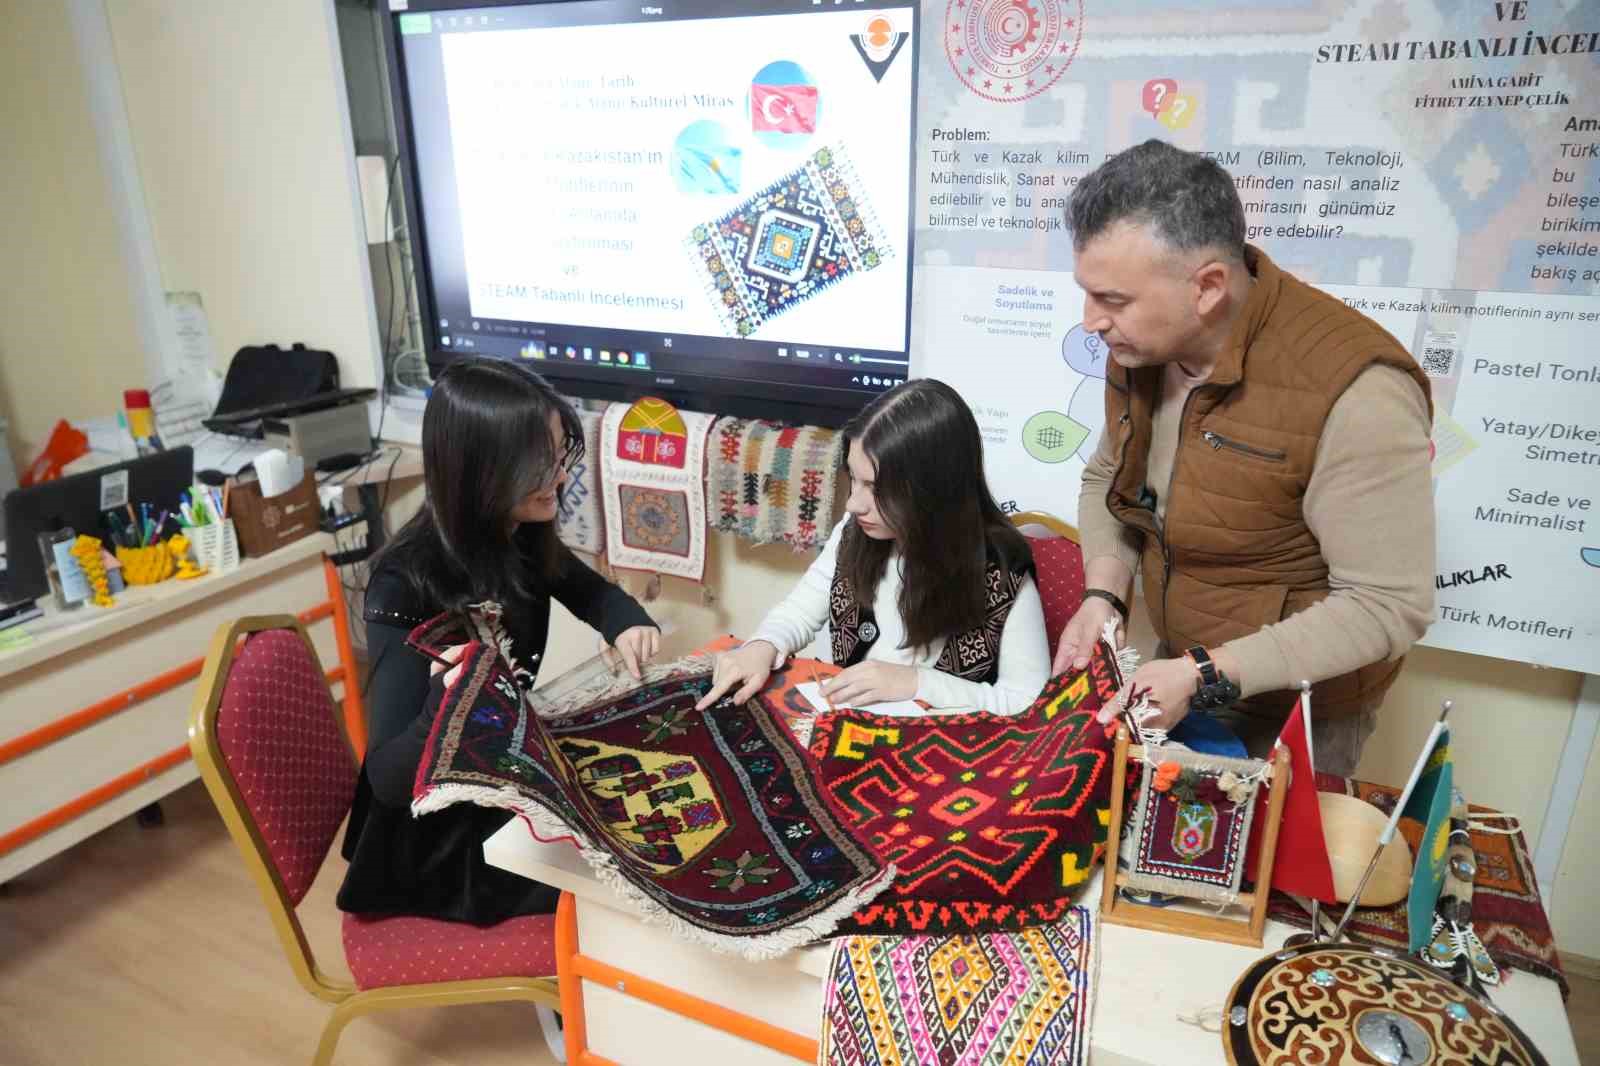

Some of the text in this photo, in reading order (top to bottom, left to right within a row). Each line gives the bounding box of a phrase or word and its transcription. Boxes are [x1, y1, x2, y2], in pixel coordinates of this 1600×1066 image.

[1495, 0, 1528, 22] VE
[1316, 41, 1400, 63] STEAM
[1406, 36, 1518, 60] TABANLI
[1450, 73, 1544, 89] AMİNA GABİT
[1468, 95, 1524, 108] ZEYNEP
[1526, 91, 1570, 109] ÇELİK
[1564, 116, 1600, 132] Am
[932, 128, 990, 141] Problem:
[932, 150, 1089, 164] Türk ve Kazak kilim
[1560, 143, 1600, 158] Türk
[1258, 151, 1306, 168] (Bilim,
[1326, 152, 1404, 170] Teknoloji,
[930, 172, 1078, 186] Mühendislik, Sanat ve
[1233, 174, 1400, 192] tifinden nasıl analiz
[1552, 168, 1576, 183] bu
[930, 193, 1064, 208] edilebilir ve bu ana
[1244, 200, 1396, 218] mirasını günümüz
[929, 214, 977, 227] bilimsel
[982, 218, 996, 228] ve
[1000, 216, 1060, 232] teknolojik
[1248, 224, 1344, 240] gre edebilir?
[1536, 242, 1598, 258] şekilde
[1531, 266, 1576, 282] bakış
[998, 284, 1054, 298] Sadelik ve
[995, 298, 1053, 312] Soyutlama
[1372, 302, 1386, 310] ve
[1389, 300, 1427, 312] Kazak
[1430, 302, 1462, 314] kilim
[1465, 304, 1542, 320] motiflerinin
[1544, 310, 1574, 322] aynı
[1474, 358, 1600, 383] Pastel Tonl
[1482, 416, 1600, 446] Yatay/Dike
[1000, 500, 1020, 512] ER
[1507, 488, 1591, 510] Sade ve
[1474, 506, 1585, 532] Minimalist
[1436, 564, 1512, 590] ILIKLAR
[1440, 605, 1573, 640] Türk Motifleri
